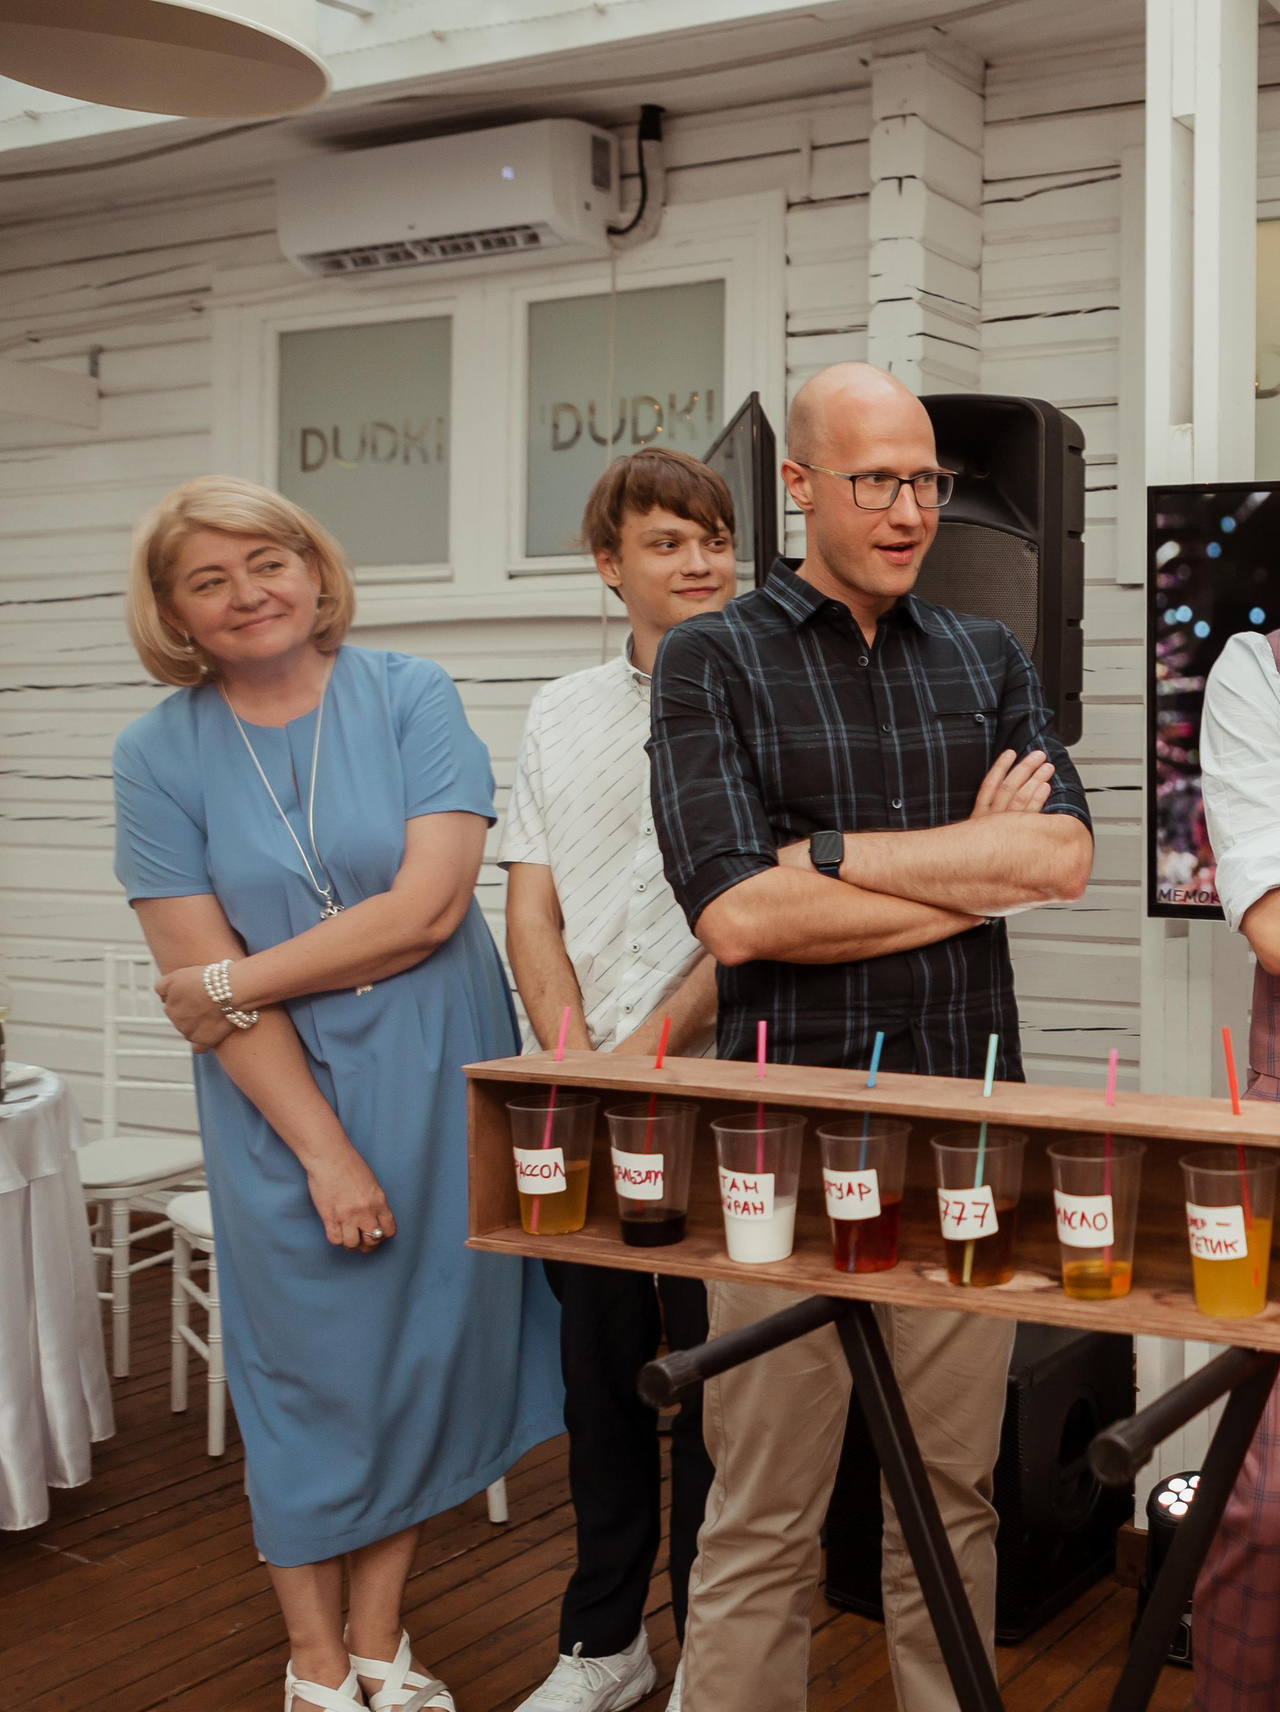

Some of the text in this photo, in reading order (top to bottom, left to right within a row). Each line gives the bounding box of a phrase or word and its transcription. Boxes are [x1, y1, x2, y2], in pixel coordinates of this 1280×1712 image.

[552, 389, 715, 451] DUDKI
[300, 416, 445, 473] DUDKI
[721, 1174, 759, 1194] ТАН
[940, 1197, 989, 1228] 777
